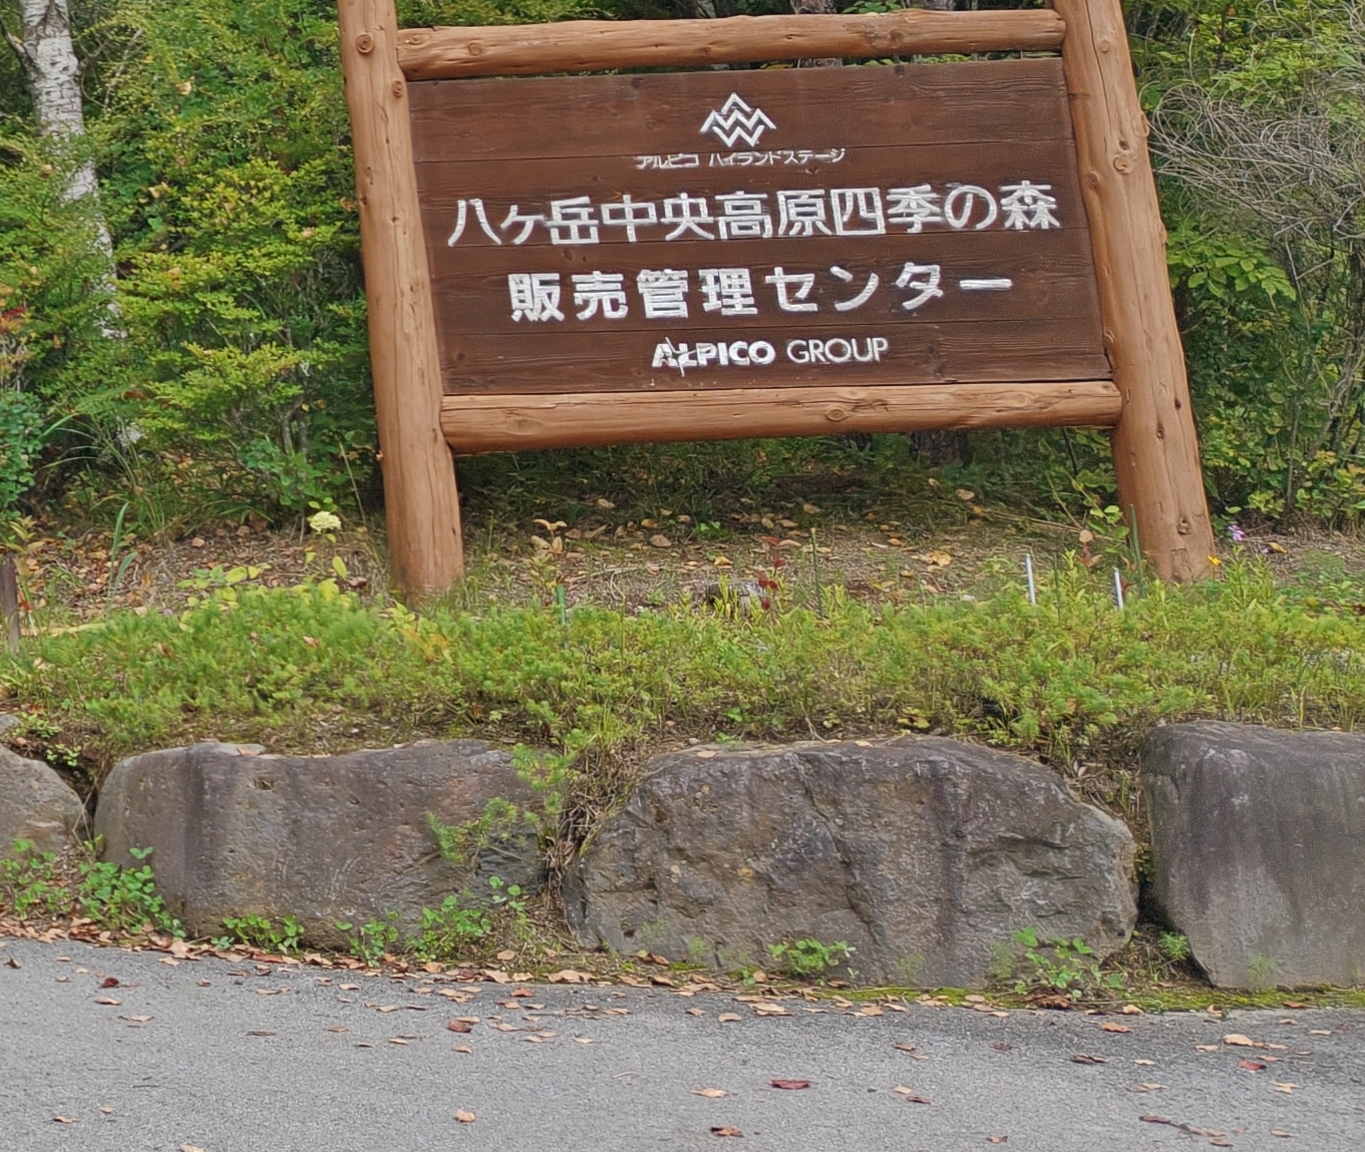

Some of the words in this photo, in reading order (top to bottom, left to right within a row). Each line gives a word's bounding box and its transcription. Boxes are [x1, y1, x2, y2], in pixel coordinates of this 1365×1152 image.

[635, 154, 700, 169] アルピコ
[708, 147, 846, 168] ハイランドステージ
[447, 180, 1061, 246] 八ヶ岳中央高原四季の森
[507, 261, 1013, 322] 販売管理センター
[651, 336, 776, 377] ALPICO
[786, 337, 889, 363] GROUP
